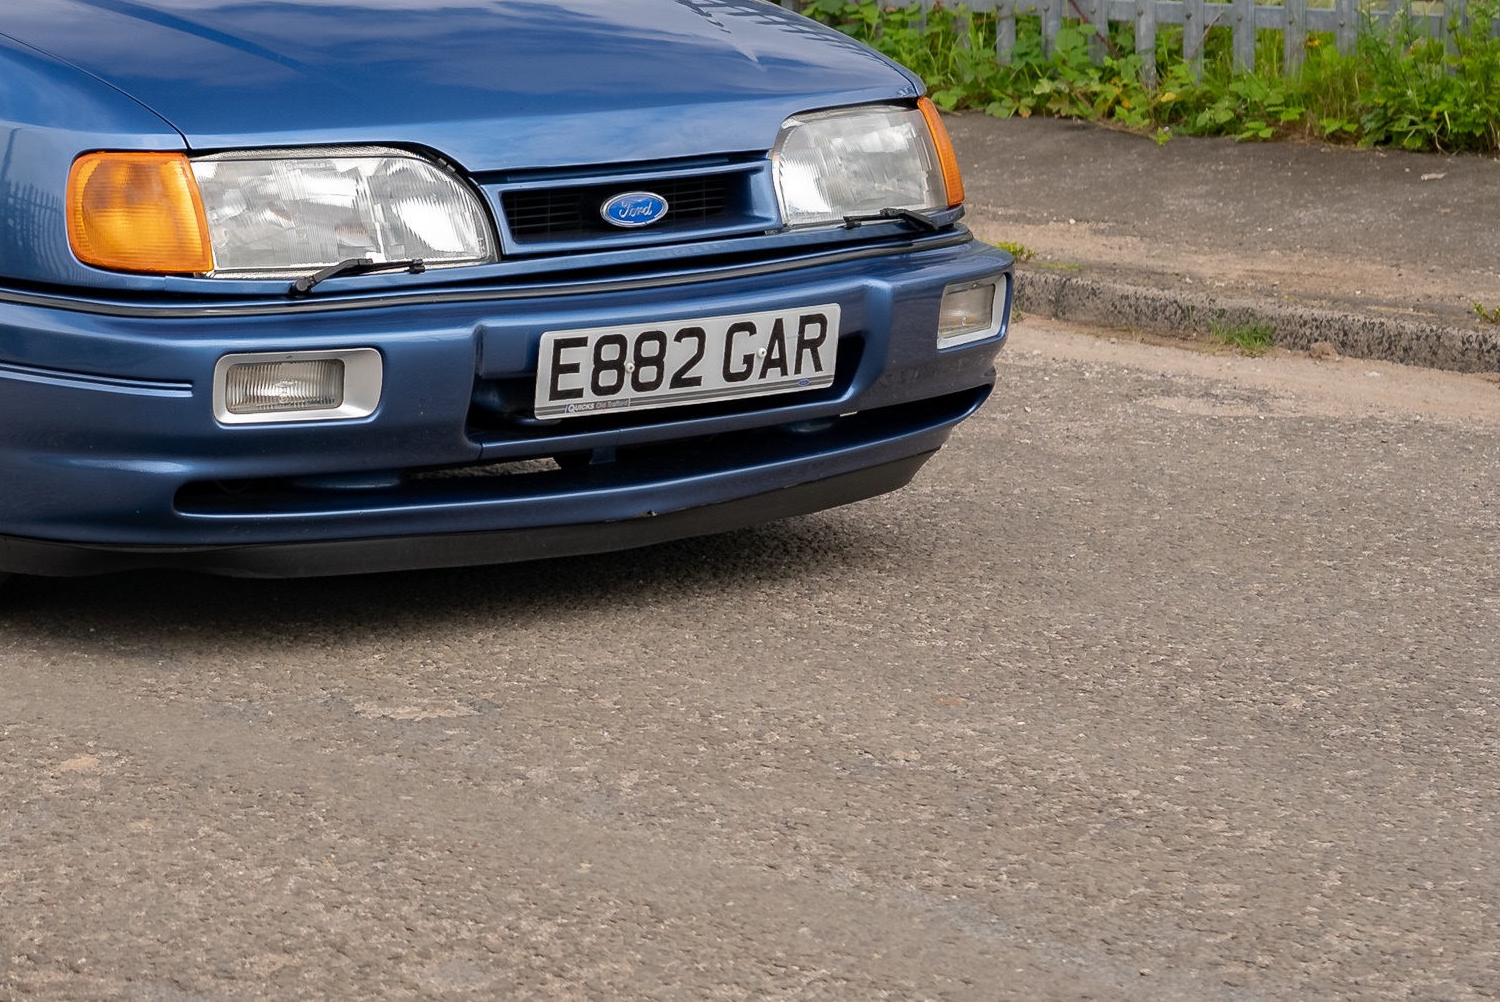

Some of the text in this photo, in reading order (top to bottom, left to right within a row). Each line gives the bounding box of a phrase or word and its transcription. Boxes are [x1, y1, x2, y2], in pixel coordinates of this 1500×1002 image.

[618, 200, 653, 218] Ford
[548, 312, 829, 402] E882 GAR
[595, 401, 607, 409] Old
